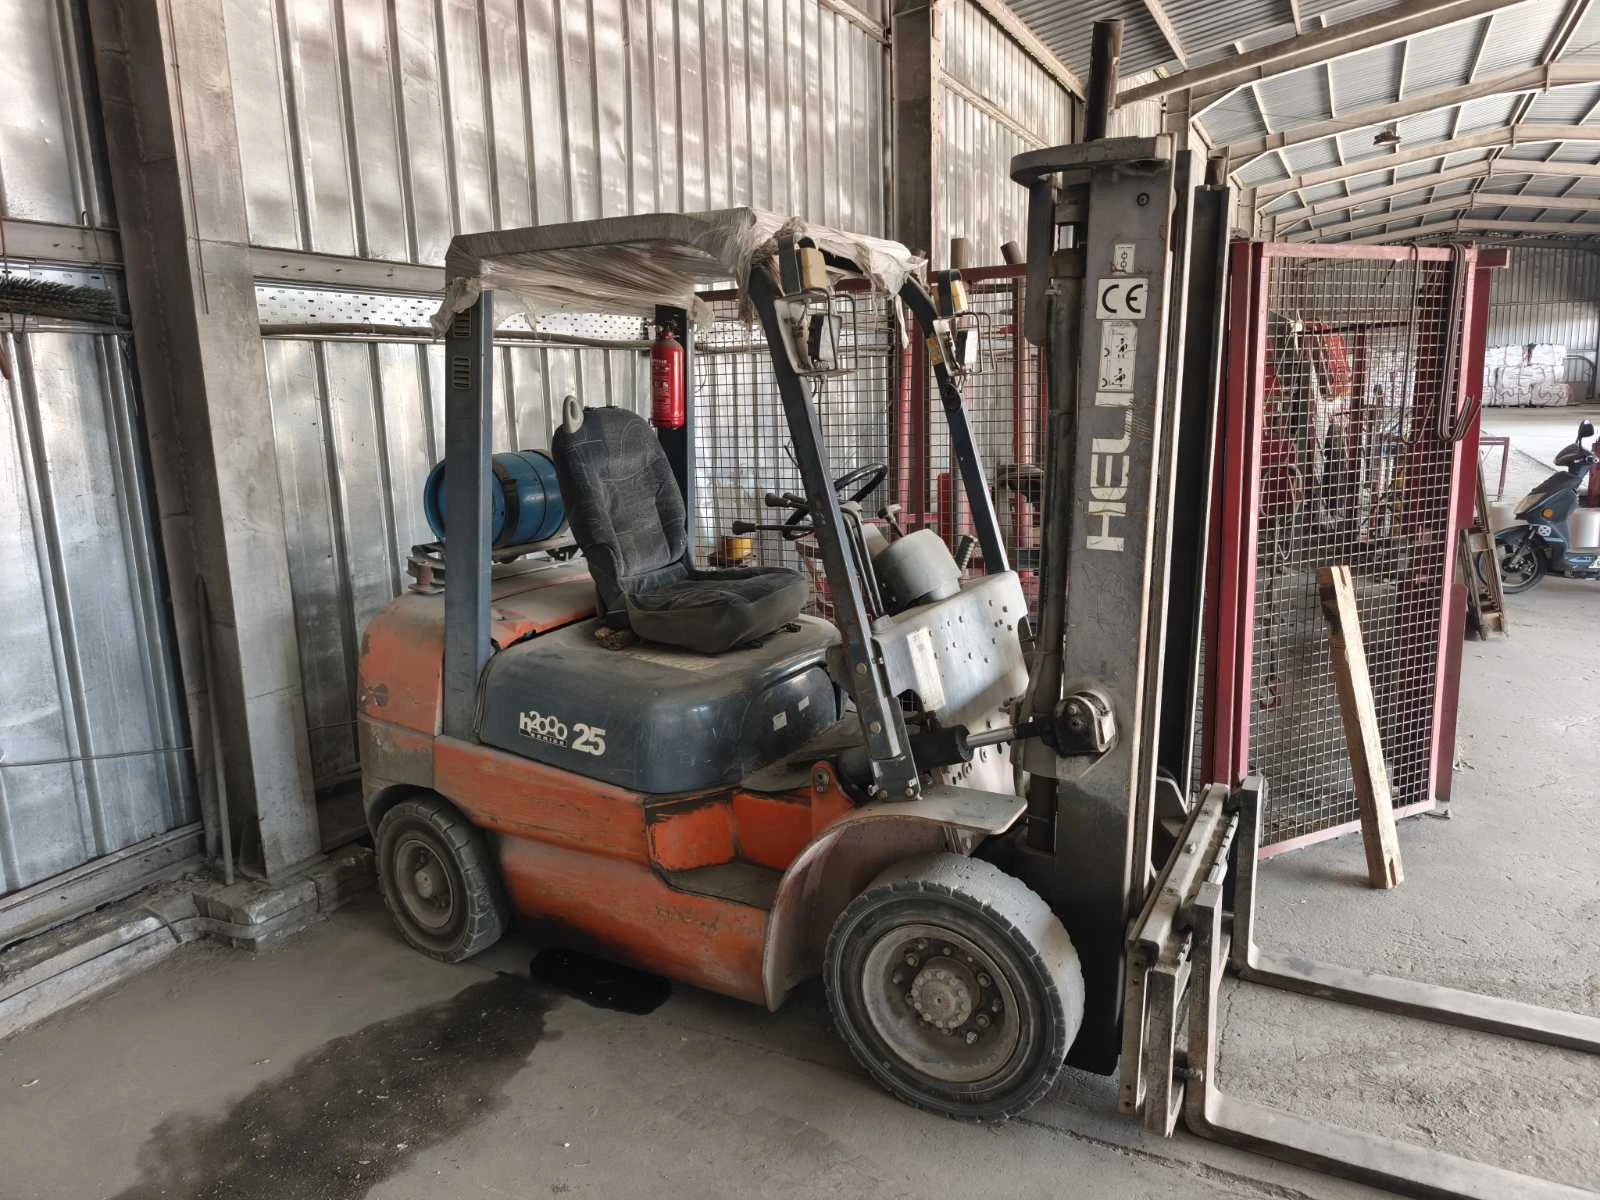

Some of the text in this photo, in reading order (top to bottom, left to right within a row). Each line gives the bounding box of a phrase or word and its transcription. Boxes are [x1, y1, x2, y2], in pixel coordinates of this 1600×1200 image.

[1101, 284, 1143, 314] CE
[1086, 392, 1134, 552] HELI
[572, 723, 606, 756] 25
